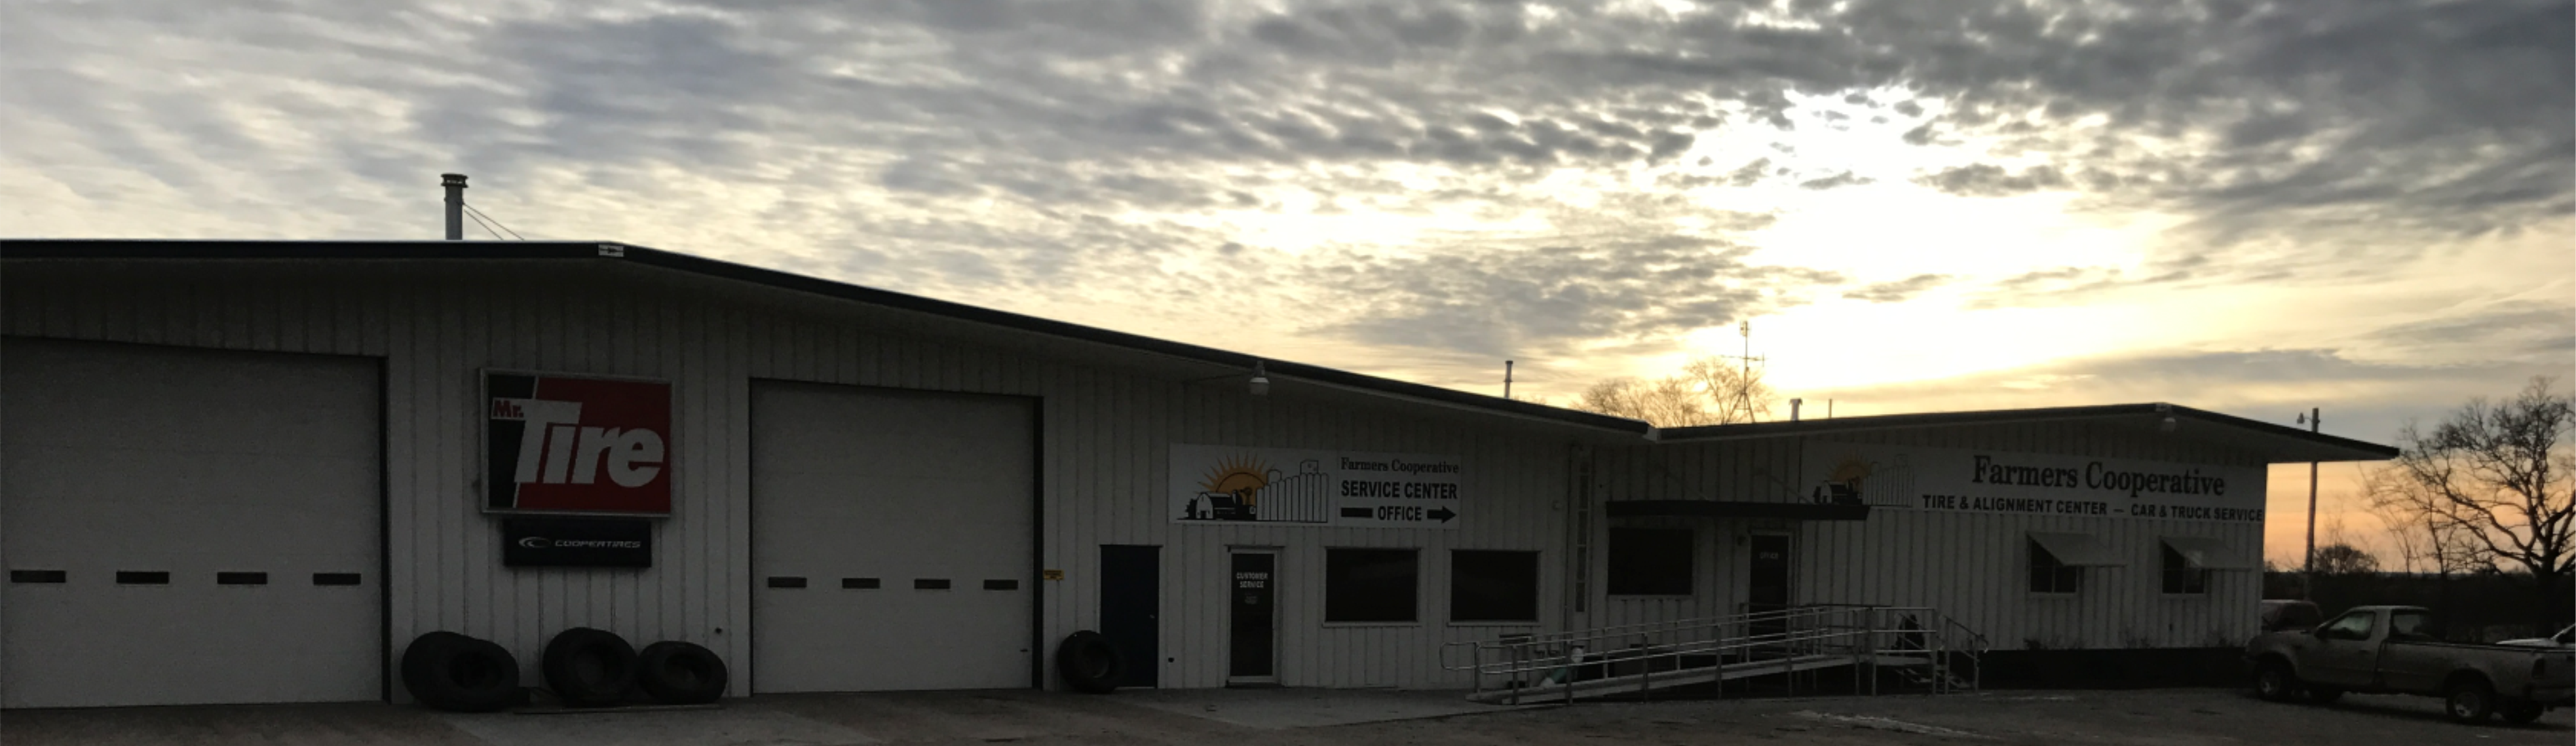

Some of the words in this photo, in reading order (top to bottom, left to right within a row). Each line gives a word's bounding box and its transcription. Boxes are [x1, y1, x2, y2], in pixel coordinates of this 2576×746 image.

[493, 400, 523, 418] Mr.
[514, 399, 665, 488] Tire
[1341, 457, 1388, 472] Farmers
[1392, 459, 1459, 475] Cooperative
[1972, 455, 2078, 489] Farmers
[2085, 461, 2226, 498] Cooperative
[1341, 480, 1400, 498] SERVICE
[1404, 482, 1458, 498] CENTER
[1378, 506, 1422, 521] OFFICE
[1922, 494, 1956, 509] TIRE
[1960, 496, 1969, 510] &
[1973, 496, 2053, 512] ALIGNMENT
[2056, 500, 2107, 515] CENTER
[2131, 503, 2155, 517] CAR
[2159, 504, 2167, 517] &
[2170, 506, 2211, 519] TRUCK
[2214, 507, 2263, 521] SERVICE
